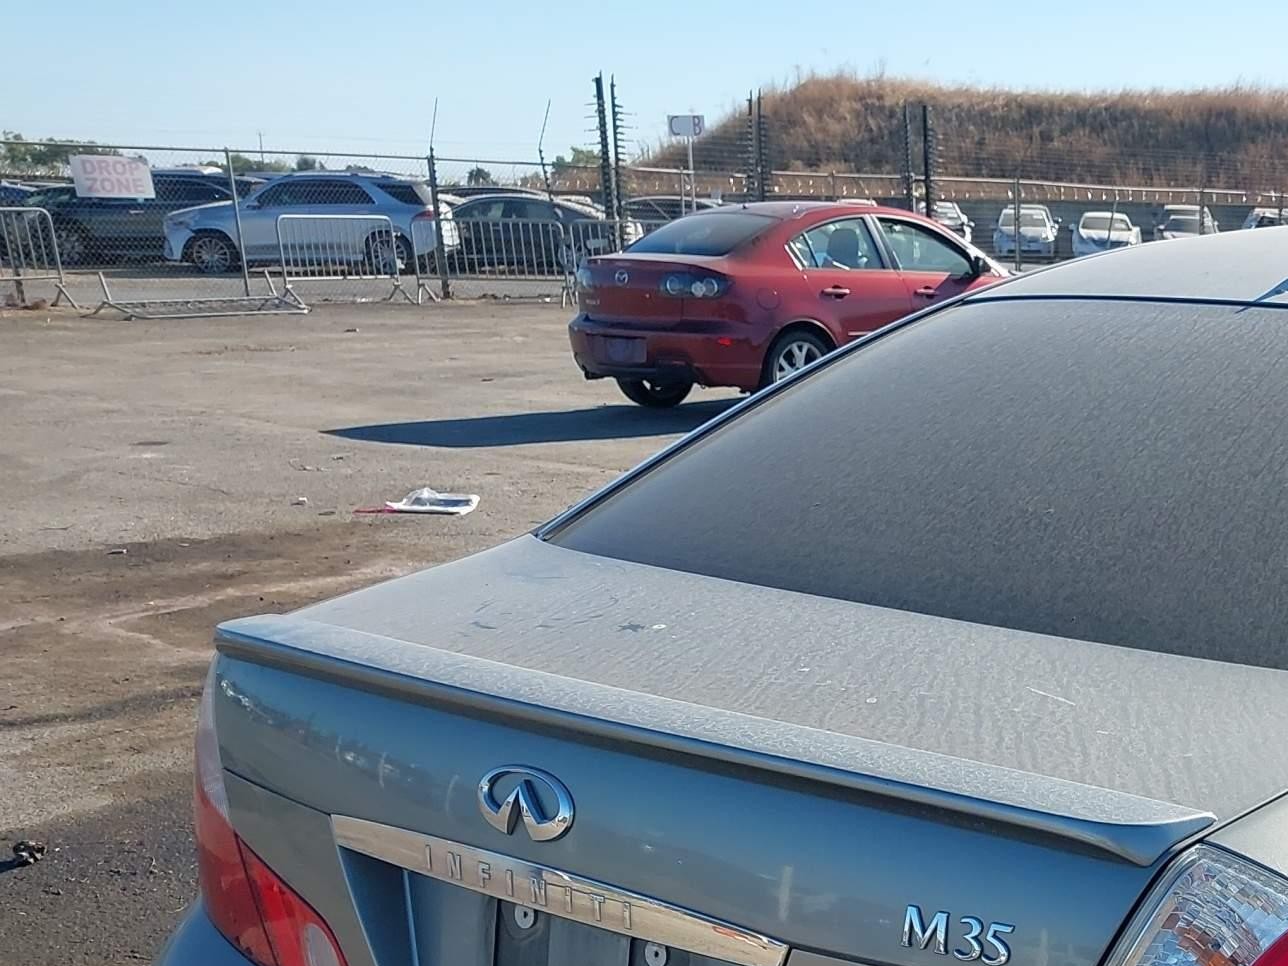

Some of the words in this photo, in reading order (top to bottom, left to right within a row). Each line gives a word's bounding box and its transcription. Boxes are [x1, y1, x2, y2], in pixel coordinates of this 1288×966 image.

[670, 115, 680, 135] C
[692, 115, 702, 136] B
[81, 159, 141, 176] DROP
[85, 177, 145, 193] ZONE
[425, 844, 632, 930] INFINITI
[900, 904, 1016, 966] M35
